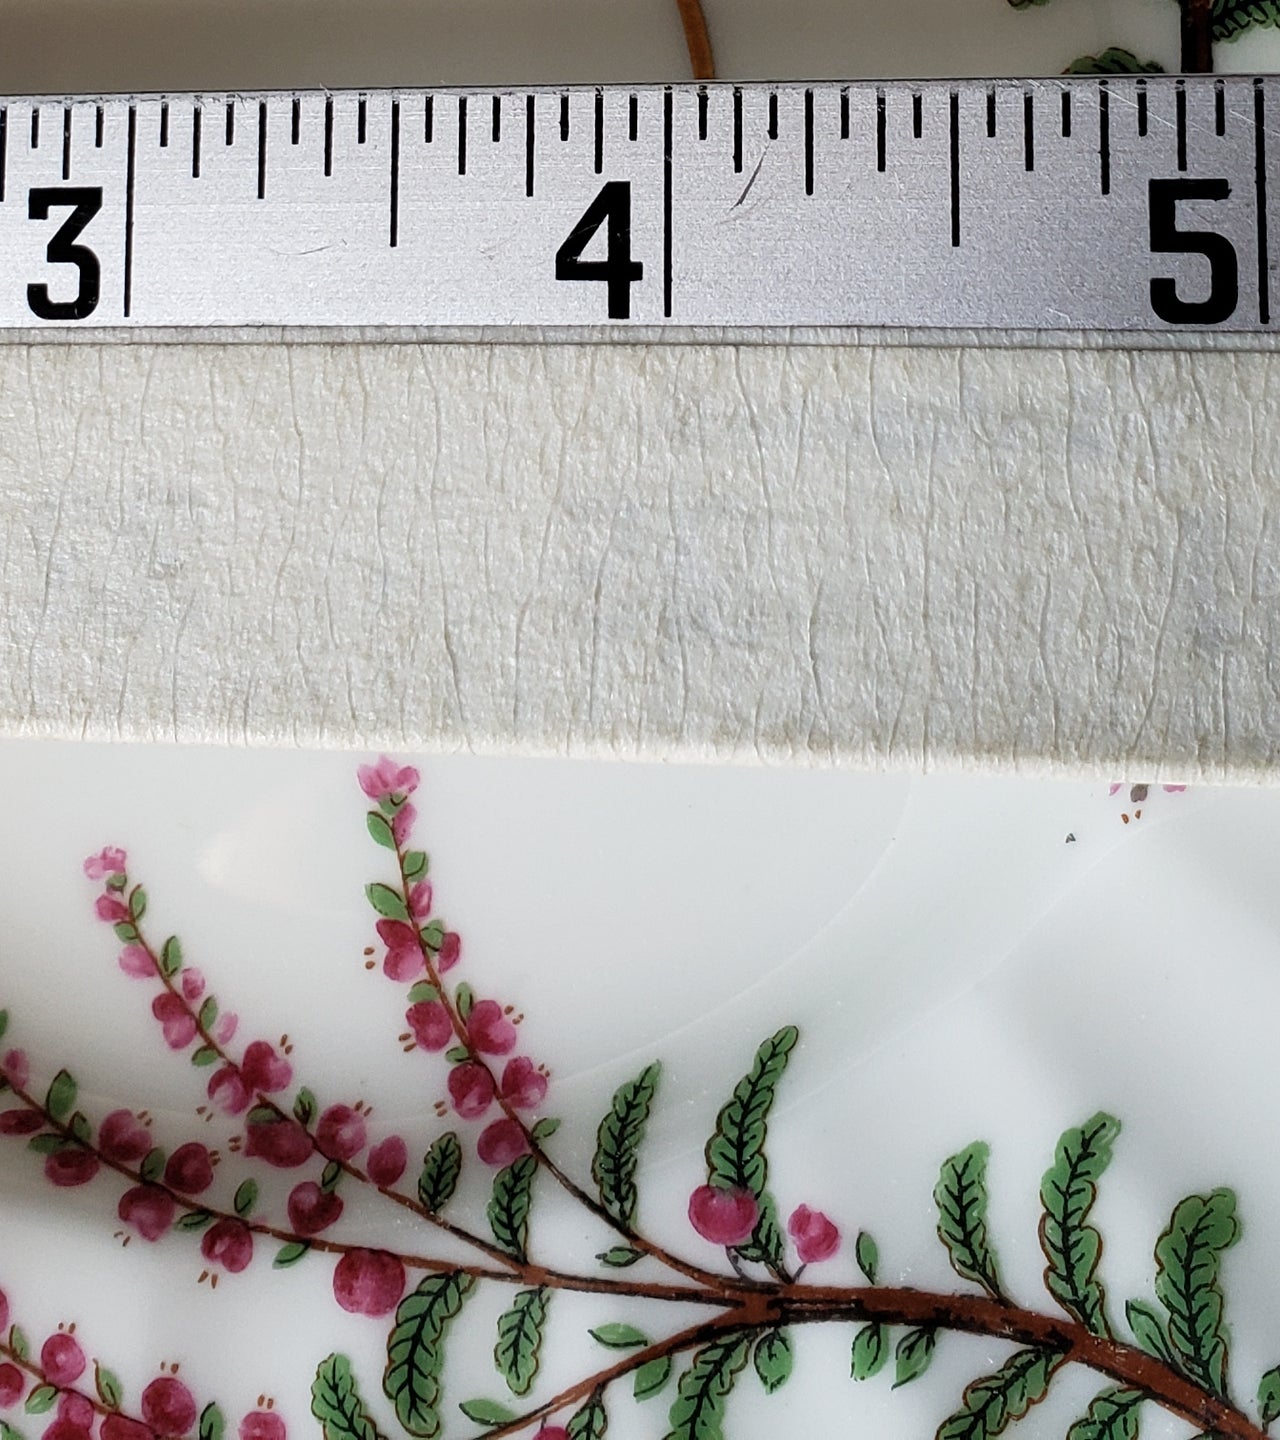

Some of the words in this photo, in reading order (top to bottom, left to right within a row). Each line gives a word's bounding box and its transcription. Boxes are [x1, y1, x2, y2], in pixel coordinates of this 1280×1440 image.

[26, 186, 104, 321] 3
[555, 181, 644, 320] 4
[1148, 177, 1239, 325] 5
